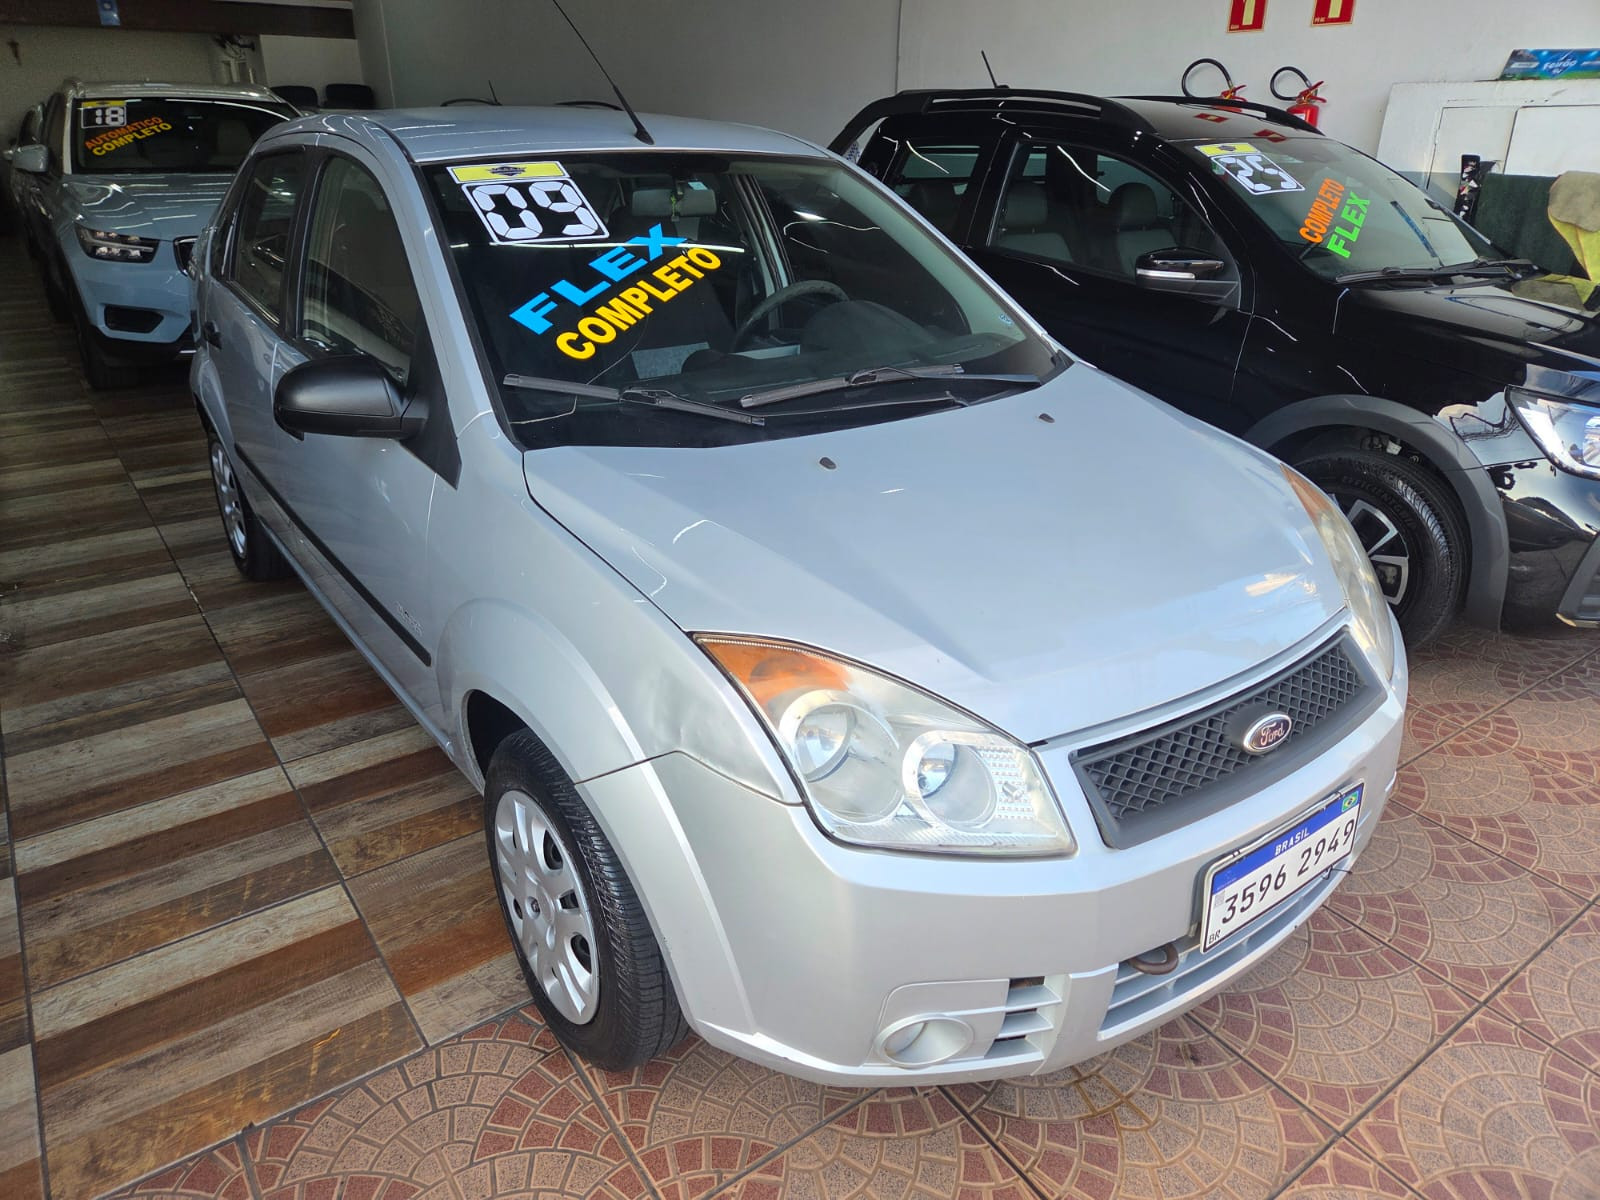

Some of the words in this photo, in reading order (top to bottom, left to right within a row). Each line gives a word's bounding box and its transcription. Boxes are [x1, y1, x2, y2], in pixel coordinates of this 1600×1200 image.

[92, 123, 172, 156] COMPLETO
[472, 181, 598, 239] 09
[1299, 177, 1345, 243] COMPLETO
[1326, 191, 1371, 259] FLEX
[509, 223, 687, 335] FLEX
[556, 247, 721, 360] COMPLETO
[1260, 722, 1284, 746] Ford
[1222, 864, 1287, 924] 3596
[1297, 819, 1354, 877] 2949
[1275, 827, 1310, 857] BRASIL
[1209, 930, 1221, 945] BR
